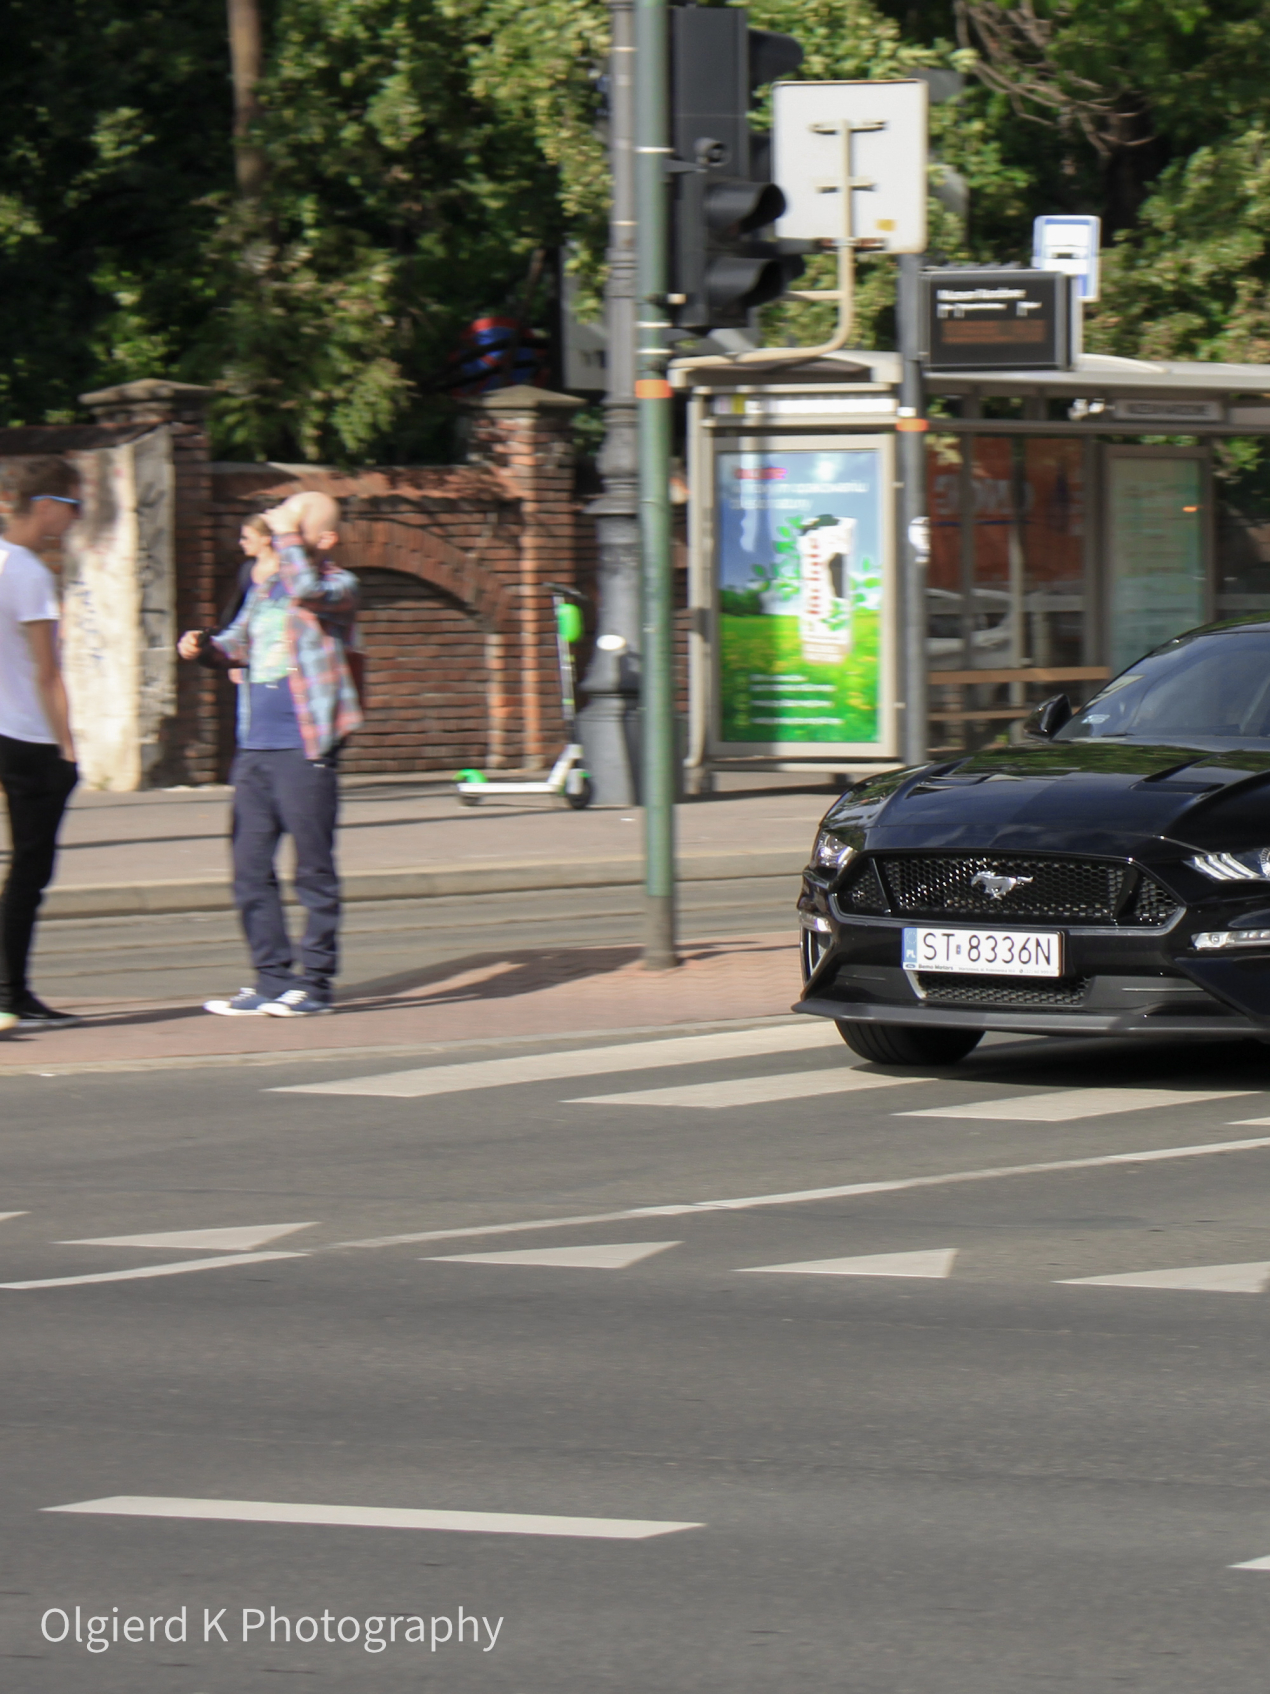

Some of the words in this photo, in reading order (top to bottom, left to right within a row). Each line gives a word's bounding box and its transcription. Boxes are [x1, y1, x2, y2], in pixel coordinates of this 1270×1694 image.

[906, 949, 916, 959] PL
[923, 932, 956, 961] ST
[967, 934, 1052, 966] 8336N
